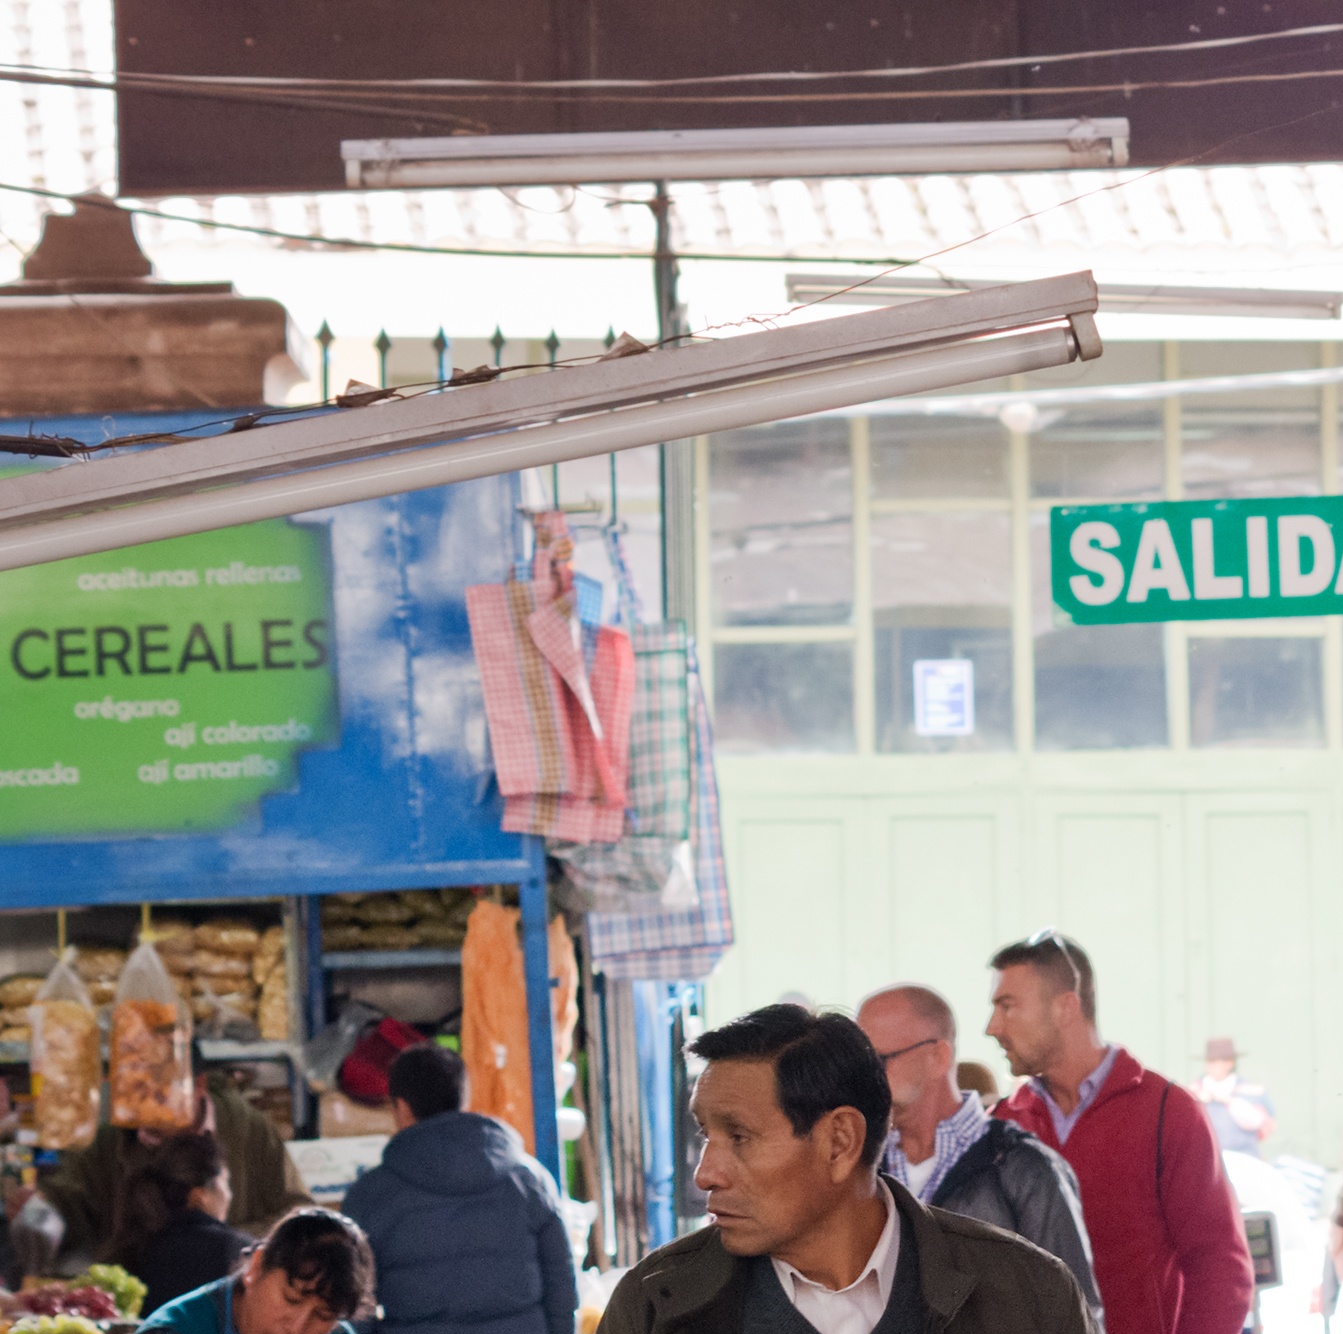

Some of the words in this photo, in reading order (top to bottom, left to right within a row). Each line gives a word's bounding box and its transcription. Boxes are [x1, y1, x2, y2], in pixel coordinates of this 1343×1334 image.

[76, 567, 199, 591] aceitunas
[205, 562, 301, 585] rellenas
[10, 618, 330, 681] CEREALES
[74, 696, 180, 722] orégano
[164, 722, 196, 749] ají
[202, 718, 311, 745] colorado
[137, 759, 169, 785] ají
[173, 755, 280, 781] amarillo
